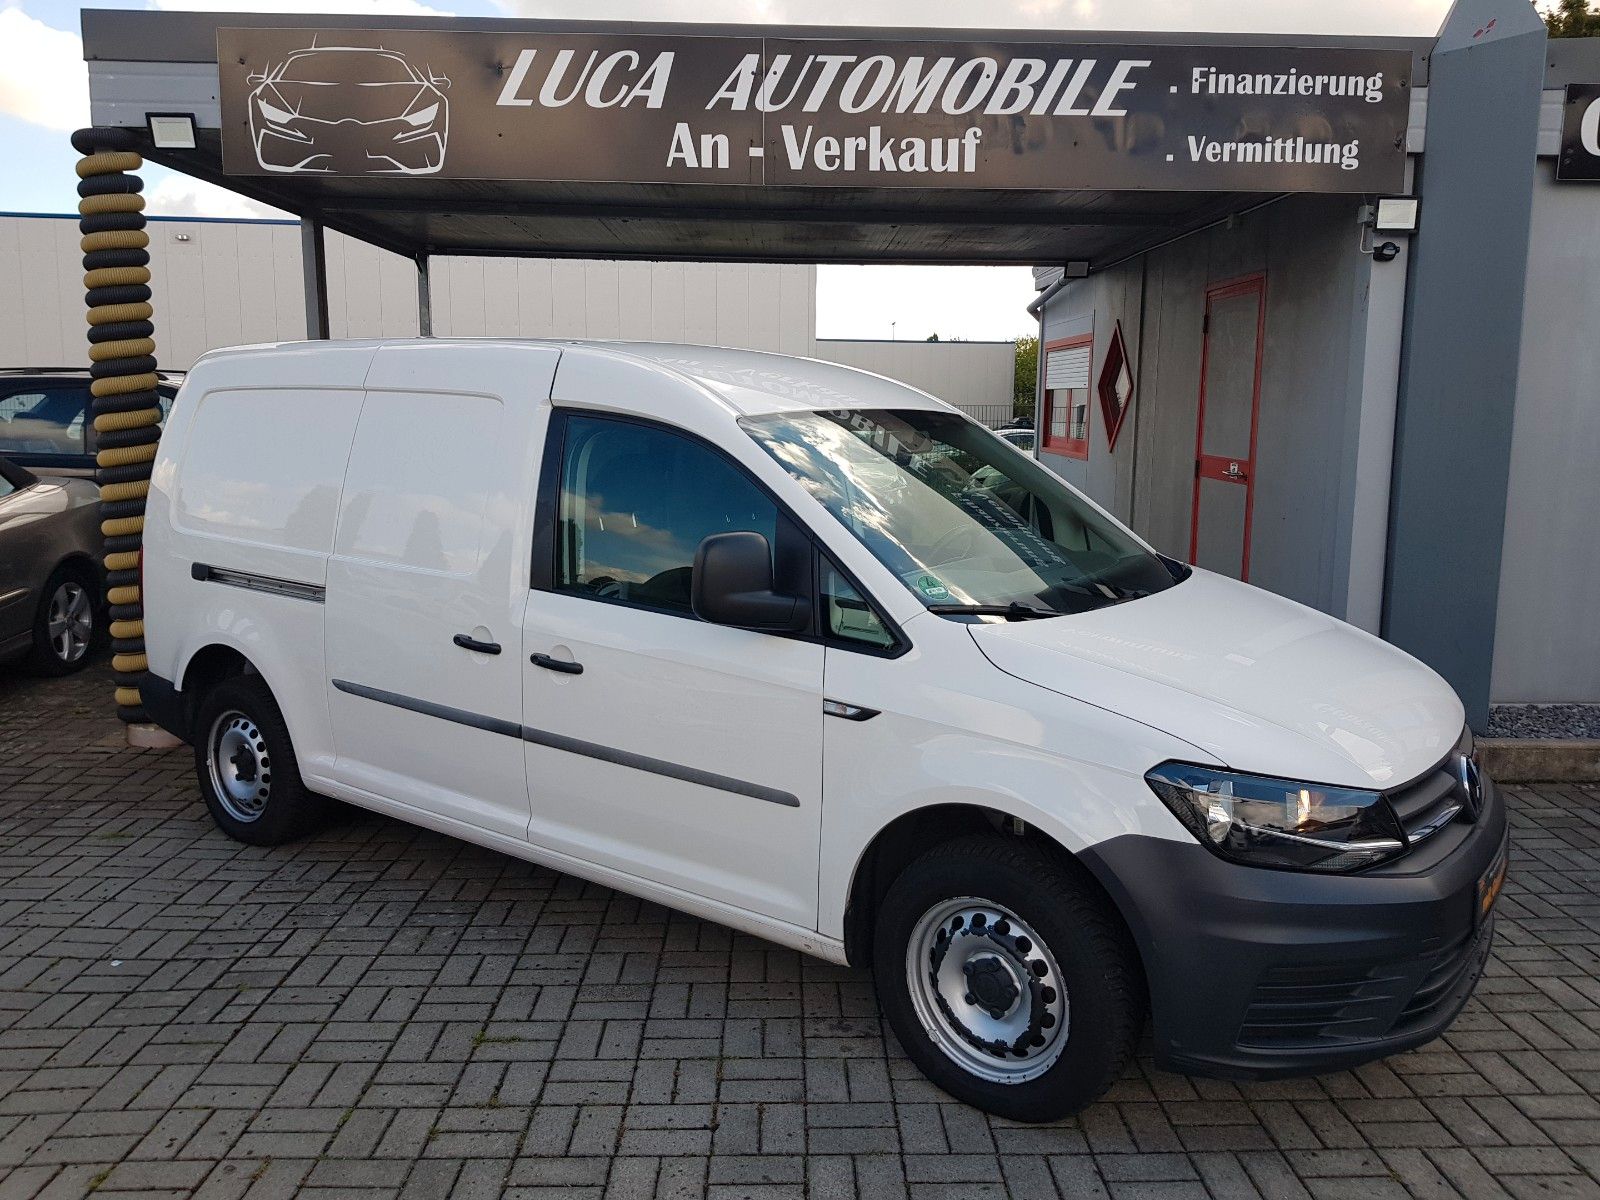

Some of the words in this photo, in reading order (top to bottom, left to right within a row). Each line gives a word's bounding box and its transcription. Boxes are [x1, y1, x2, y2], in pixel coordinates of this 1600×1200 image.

[495, 49, 675, 109] LUCA
[704, 53, 1152, 117] AUTOMOBILE
[1191, 67, 1383, 103] Finanzierung
[666, 122, 729, 169] An
[781, 124, 983, 173] Verkauf
[1187, 135, 1359, 170] Vermittlung
